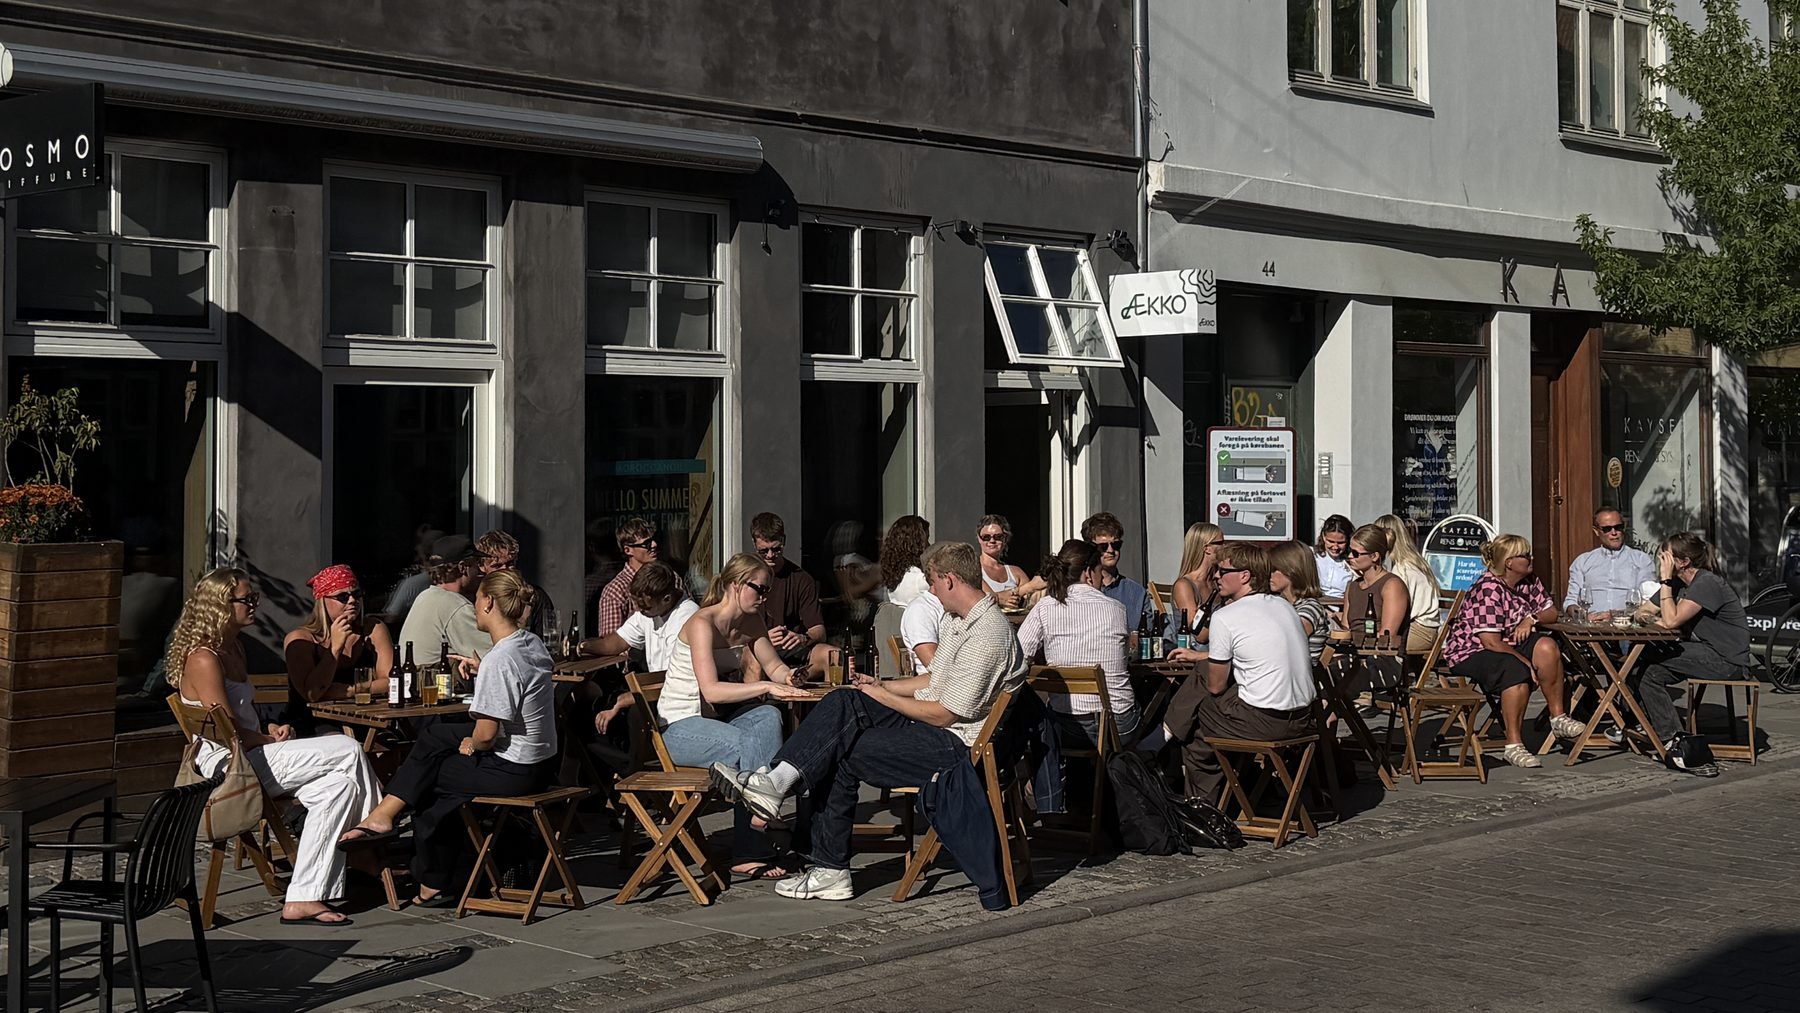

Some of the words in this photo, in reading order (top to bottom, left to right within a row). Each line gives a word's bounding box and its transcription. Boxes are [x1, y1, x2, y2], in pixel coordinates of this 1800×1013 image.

[1262, 260, 1276, 277] 44
[1121, 293, 1187, 320] ÆKKO
[1442, 527, 1482, 535] KAYSER
[1746, 616, 1800, 631] Explre
